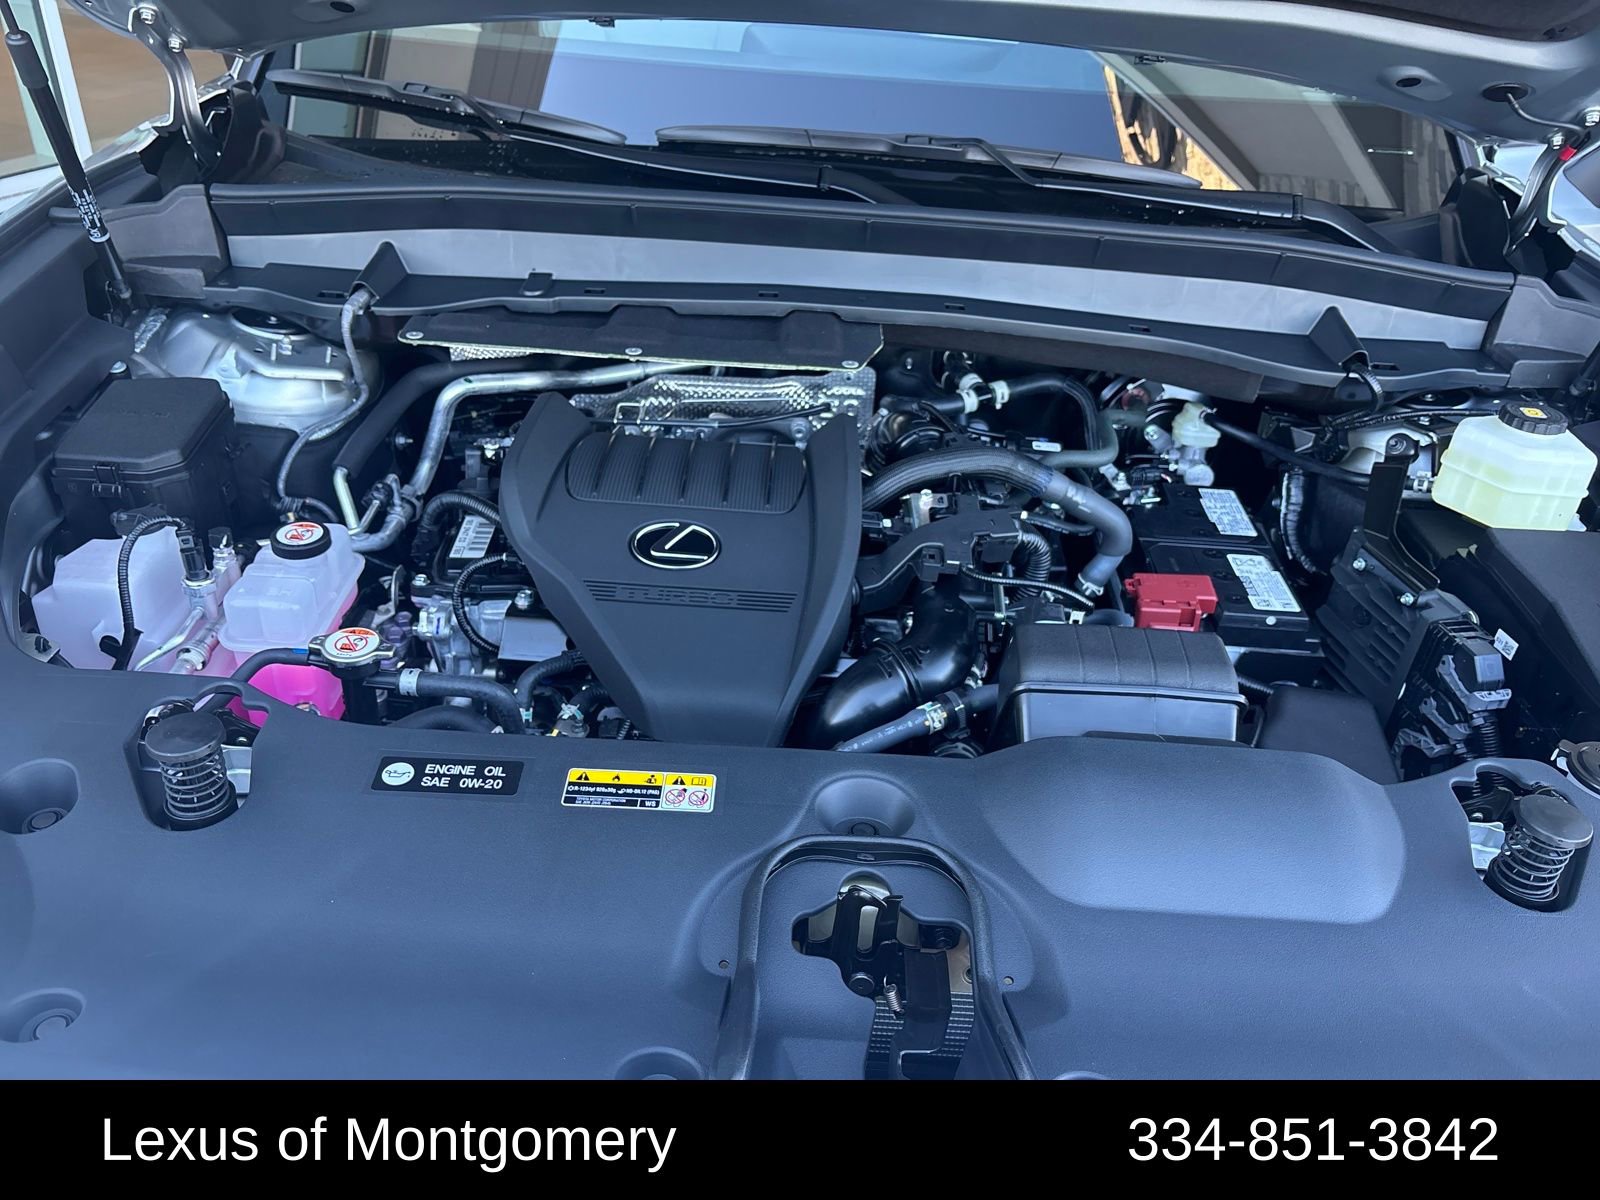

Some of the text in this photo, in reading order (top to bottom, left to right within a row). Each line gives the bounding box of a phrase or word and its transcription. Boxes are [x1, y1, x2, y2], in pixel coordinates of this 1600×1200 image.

[620, 586, 734, 606] TURBO
[424, 763, 507, 777] ENGINE OIL
[420, 776, 503, 790] SAE 0W-20
